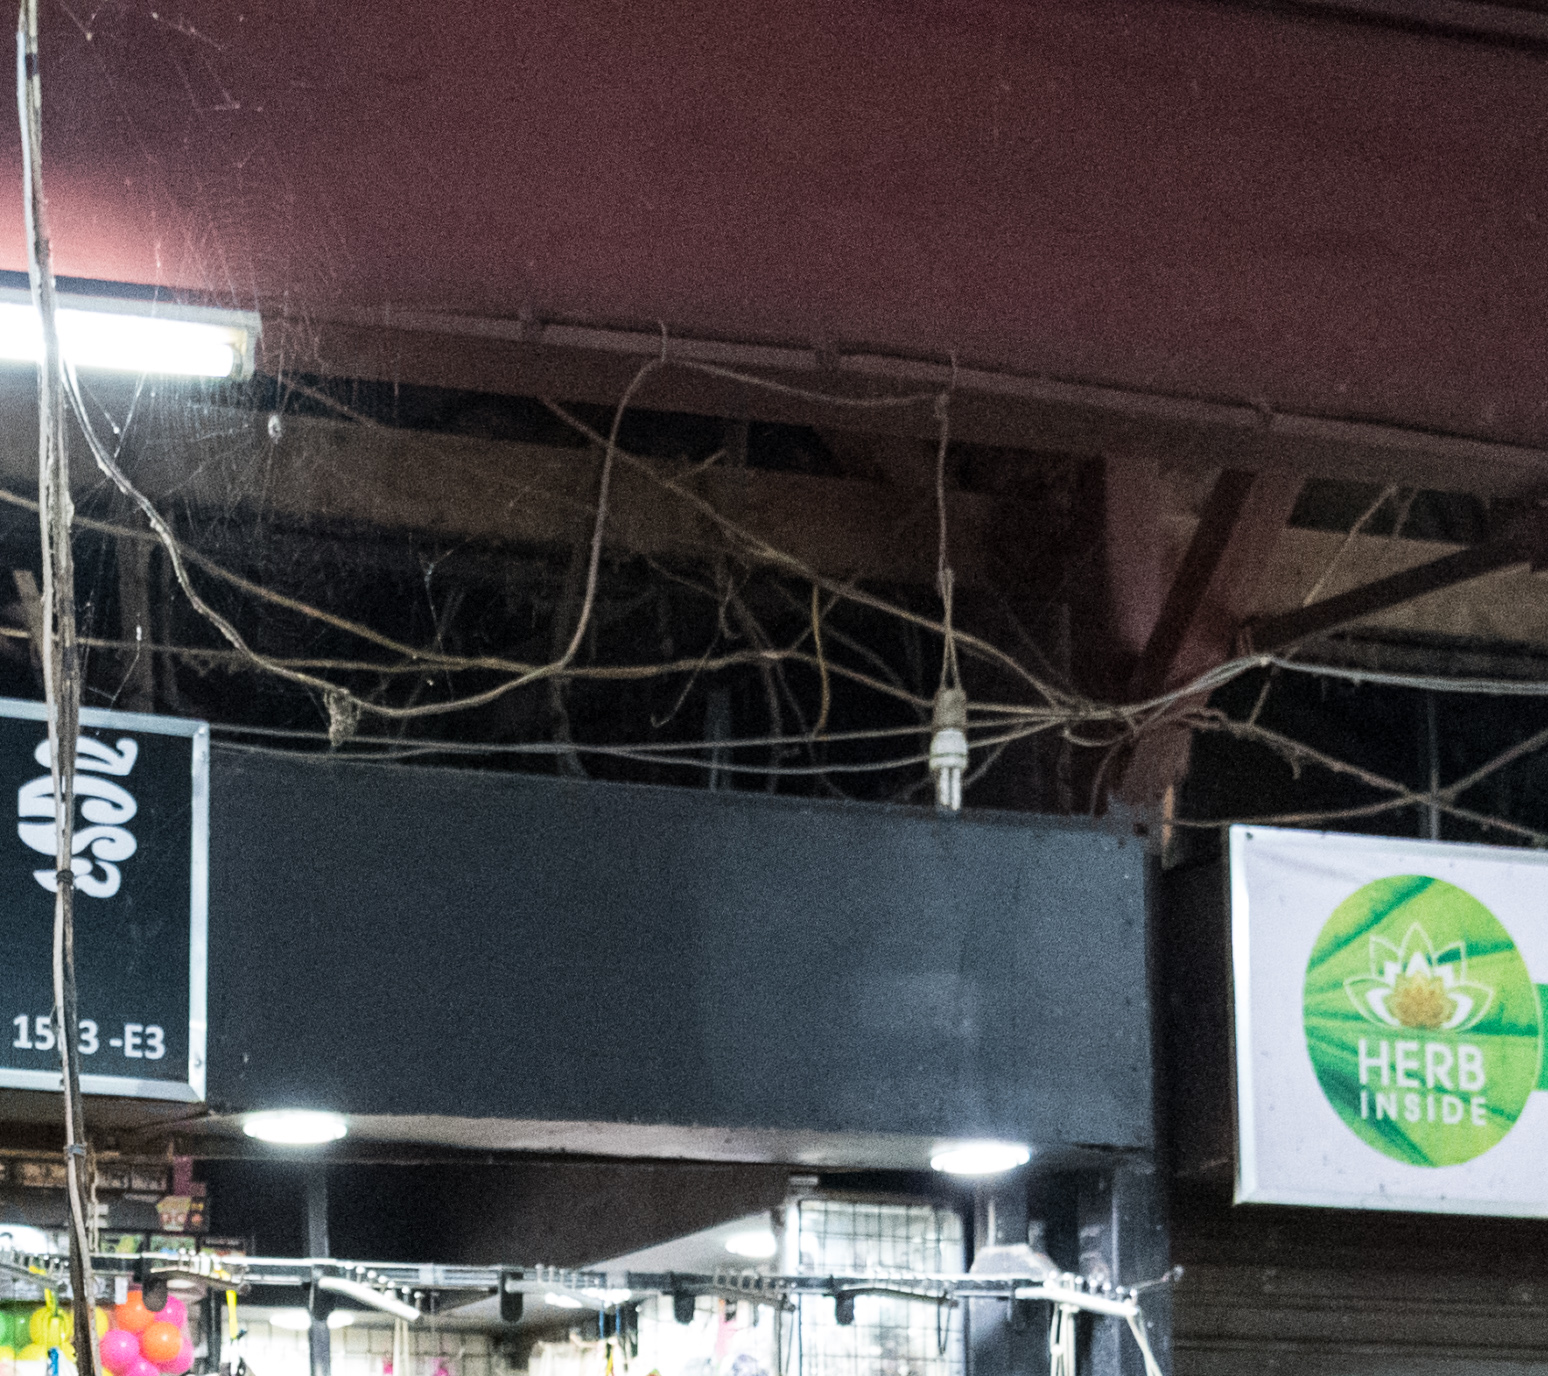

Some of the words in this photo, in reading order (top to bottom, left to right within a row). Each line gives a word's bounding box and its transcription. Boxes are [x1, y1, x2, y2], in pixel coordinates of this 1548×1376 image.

[12, 1014, 100, 1055] 153
[1358, 1038, 1486, 1092] HERB
[1360, 1089, 1488, 1127] INSIDE
